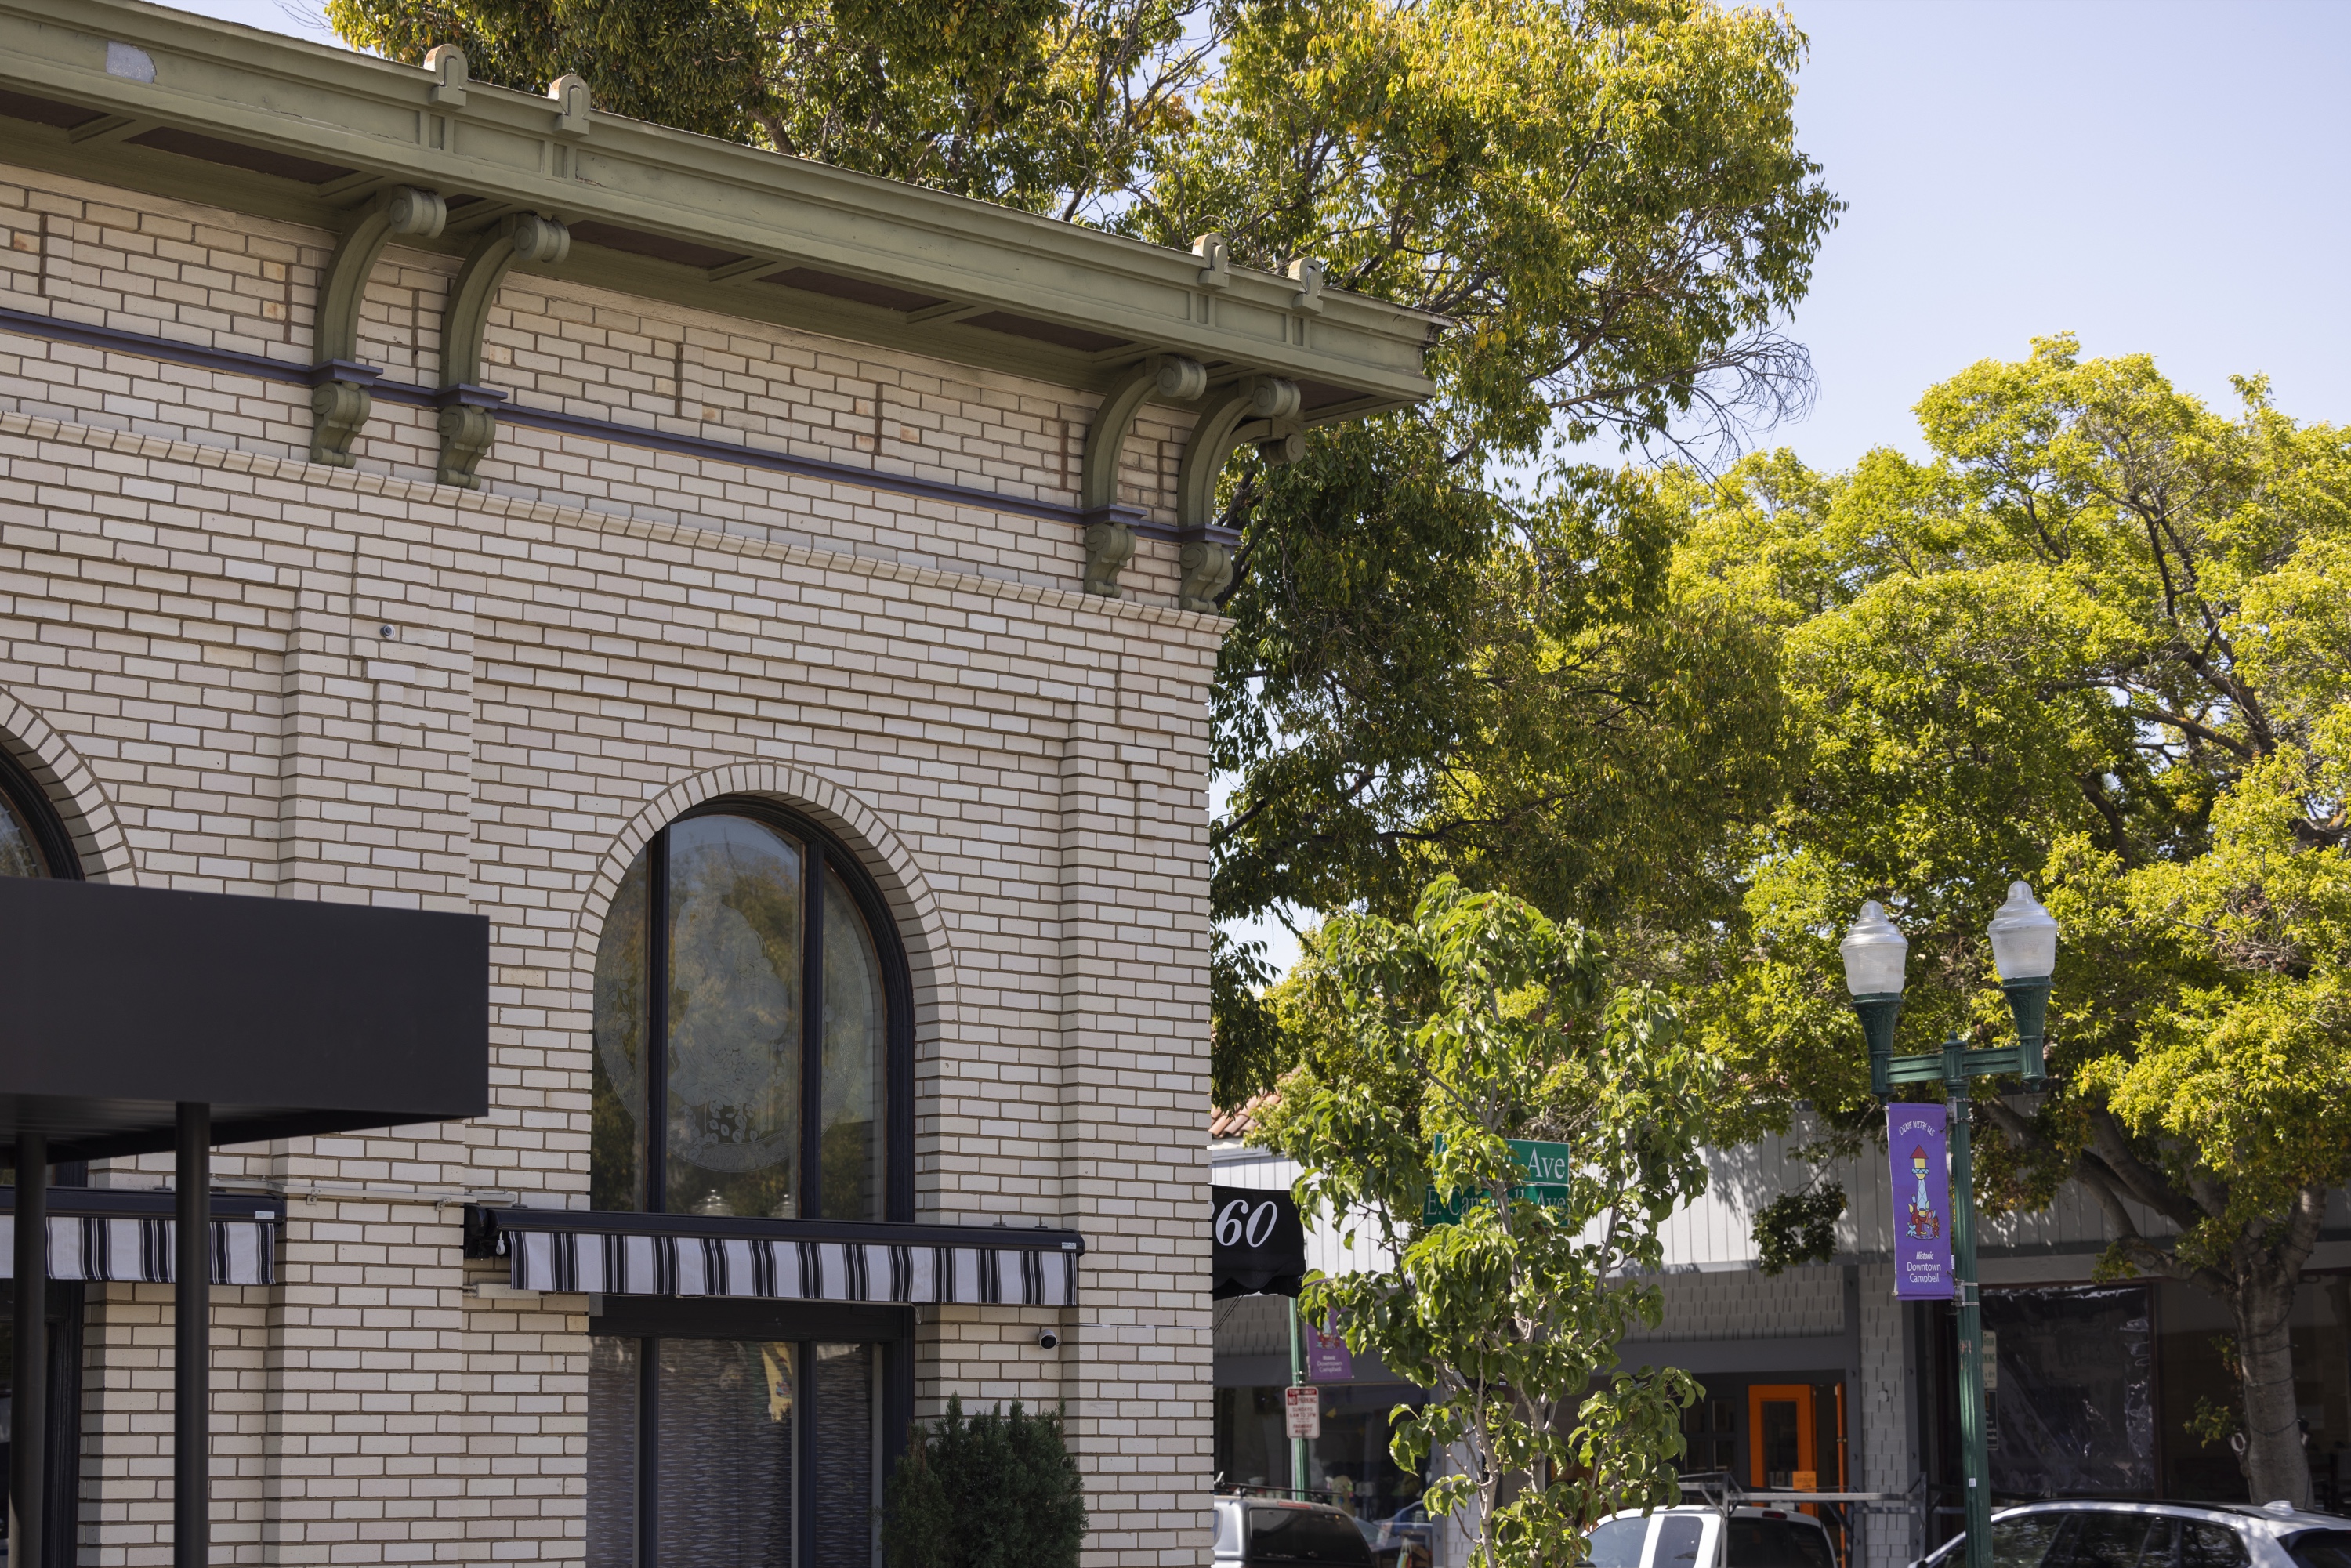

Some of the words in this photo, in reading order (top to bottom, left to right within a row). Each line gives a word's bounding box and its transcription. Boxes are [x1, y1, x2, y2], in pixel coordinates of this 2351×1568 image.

[1899, 1121, 1913, 1135] DINE
[1913, 1120, 1928, 1131] WITH
[1927, 1125, 1936, 1136] US
[1525, 1146, 1566, 1179] Ave
[1426, 1189, 1442, 1215] E.
[1208, 1199, 1278, 1248] 60
[1916, 1251, 1934, 1260] Historic
[1907, 1262, 1941, 1272] Downtown
[1909, 1273, 1940, 1285] Campbell
